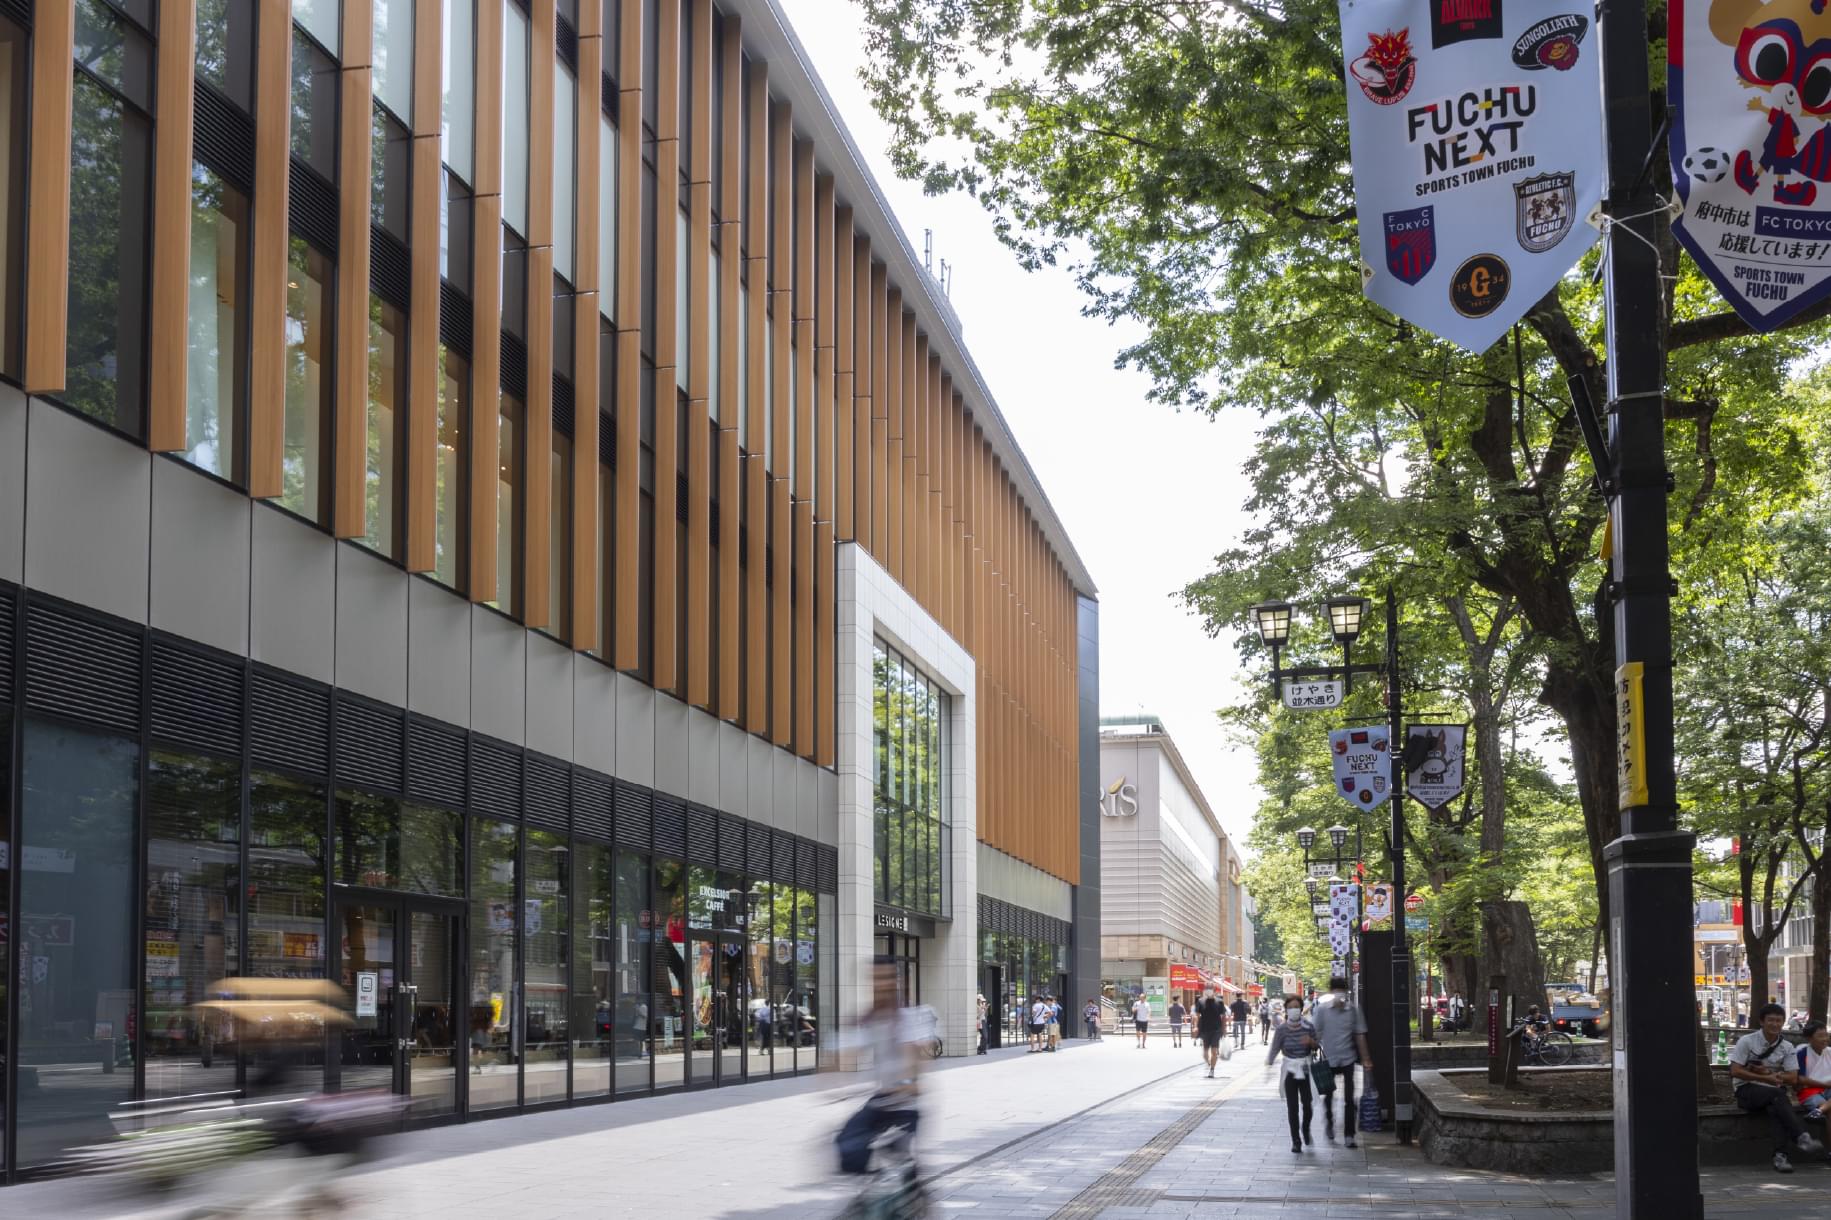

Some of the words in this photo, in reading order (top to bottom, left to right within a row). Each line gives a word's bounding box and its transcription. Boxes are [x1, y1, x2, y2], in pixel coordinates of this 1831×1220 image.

[1516, 14, 1580, 57] SUNGOLIATH
[1408, 85, 1536, 142] FUCHU
[1424, 121, 1524, 175] NEXT
[1415, 174, 1460, 197] SPORTS
[1461, 164, 1495, 184] TOWN
[1497, 155, 1535, 175] FUCHU
[1695, 200, 1752, 228] 府中市は
[1762, 215, 1781, 229] FC
[1388, 218, 1430, 232] TOKYO
[1530, 219, 1561, 238] FUCHU
[1734, 265, 1772, 283] SPORTS
[1774, 271, 1805, 286] TOWN
[1745, 282, 1789, 301] FUCHU
[1291, 684, 1335, 696] けやき
[1291, 694, 1336, 707] 並木通り
[1346, 753, 1378, 764] FUCHU
[1350, 761, 1376, 771] NEXT
